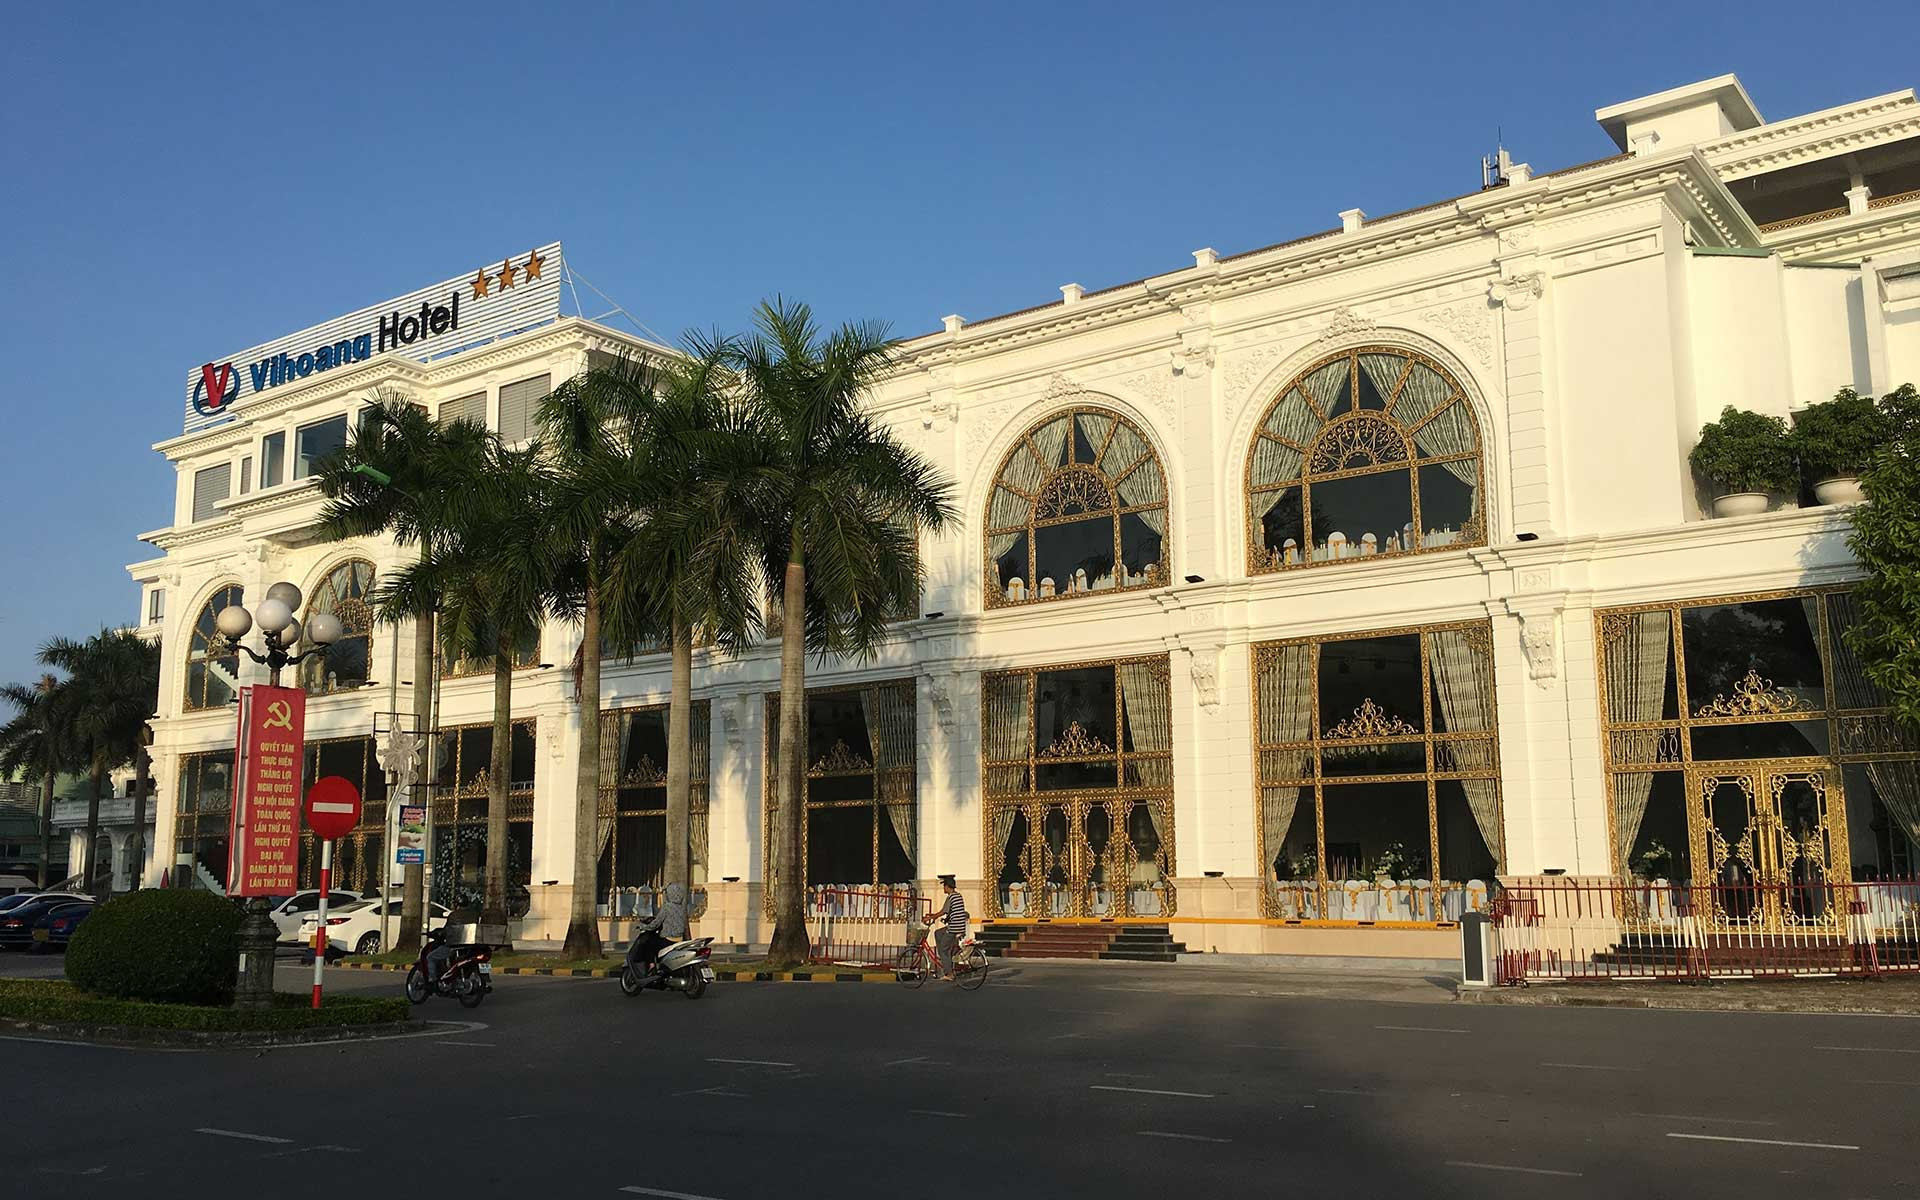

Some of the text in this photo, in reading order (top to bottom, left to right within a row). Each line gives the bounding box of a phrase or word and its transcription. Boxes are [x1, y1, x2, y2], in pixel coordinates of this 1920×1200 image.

[250, 291, 460, 392] Vihoang Hotel
[260, 741, 294, 753] QUYẾT TÂM
[261, 756, 277, 766] THỰC
[274, 782, 293, 793] QUYẾT
[274, 808, 291, 820] QUỐC
[268, 822, 280, 834] THỨ
[254, 836, 290, 848] NGHỊ QUYẾT
[263, 877, 276, 888] THỨ
